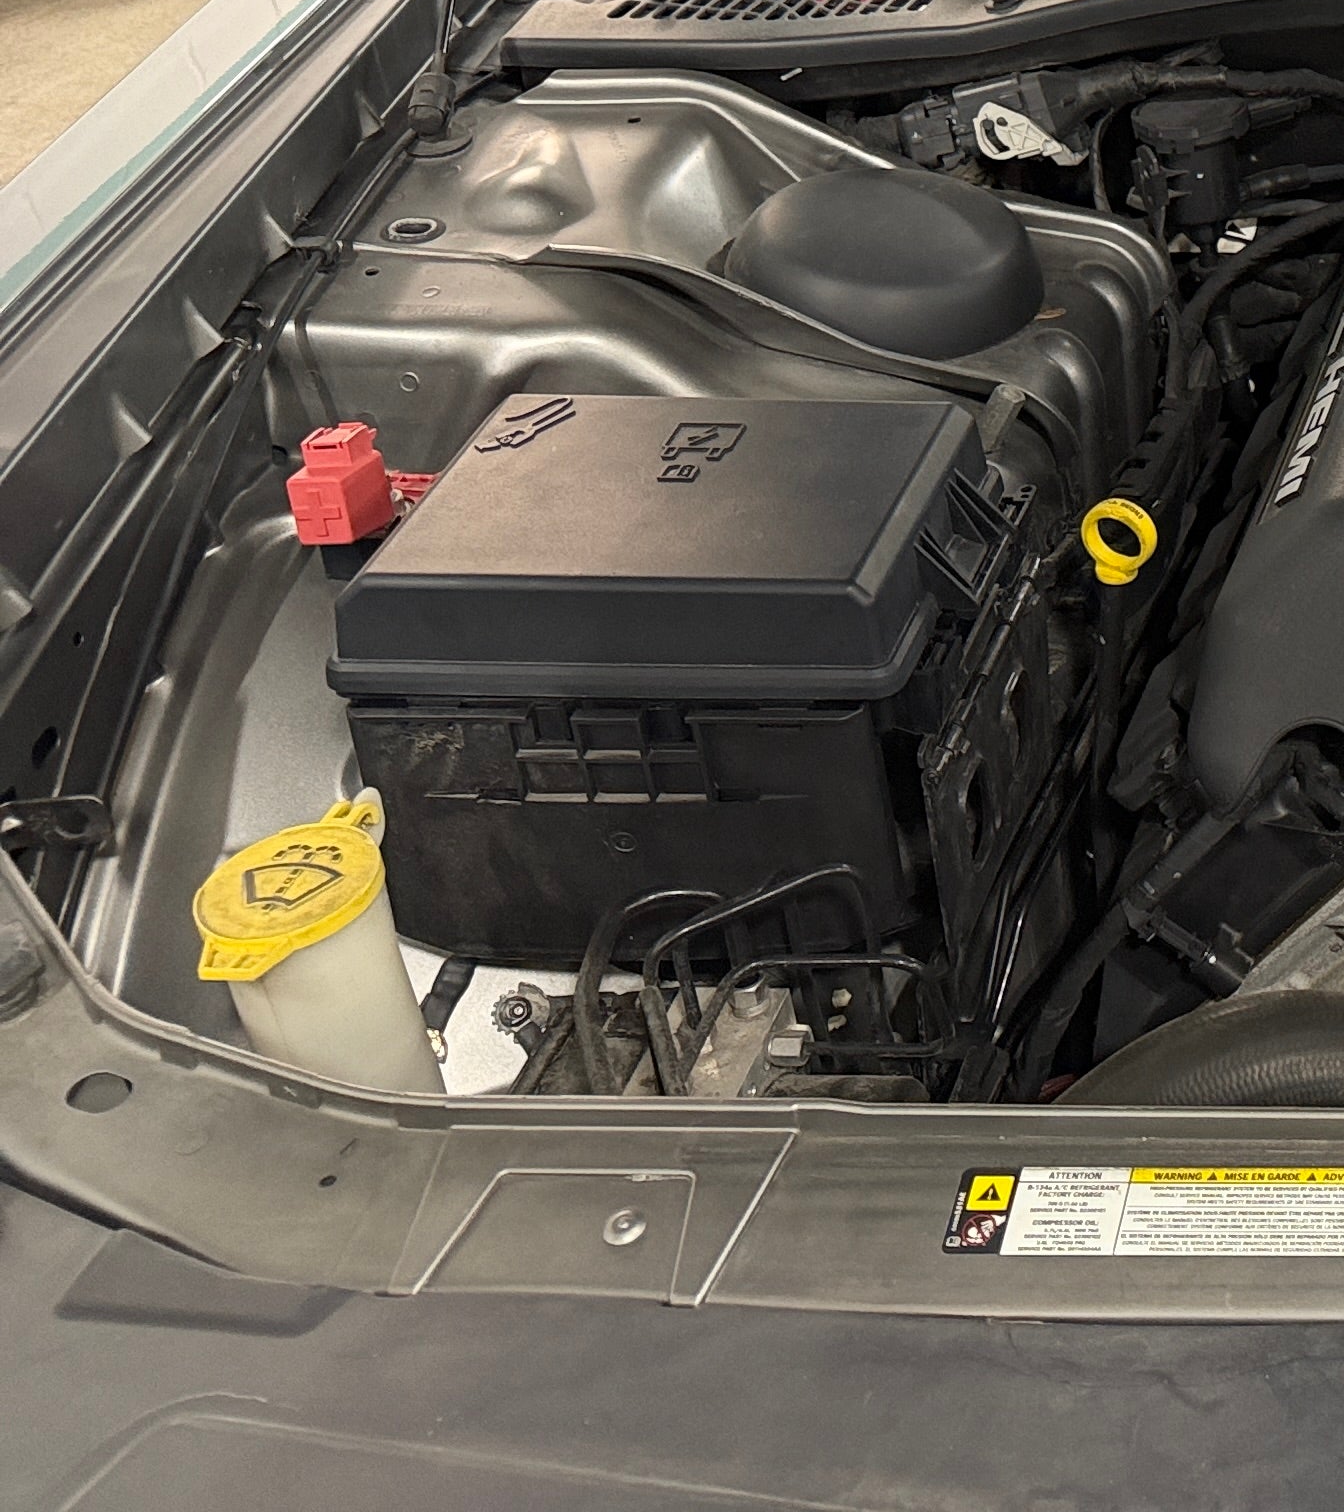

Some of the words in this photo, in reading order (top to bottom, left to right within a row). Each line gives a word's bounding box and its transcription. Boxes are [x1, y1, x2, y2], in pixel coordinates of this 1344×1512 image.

[1049, 1172, 1102, 1180] ATTENTION
[1154, 1172, 1202, 1181] WARNING
[1224, 1172, 1249, 1181] MISE
[1251, 1172, 1266, 1181] EN
[1268, 1173, 1301, 1181] GARDE
